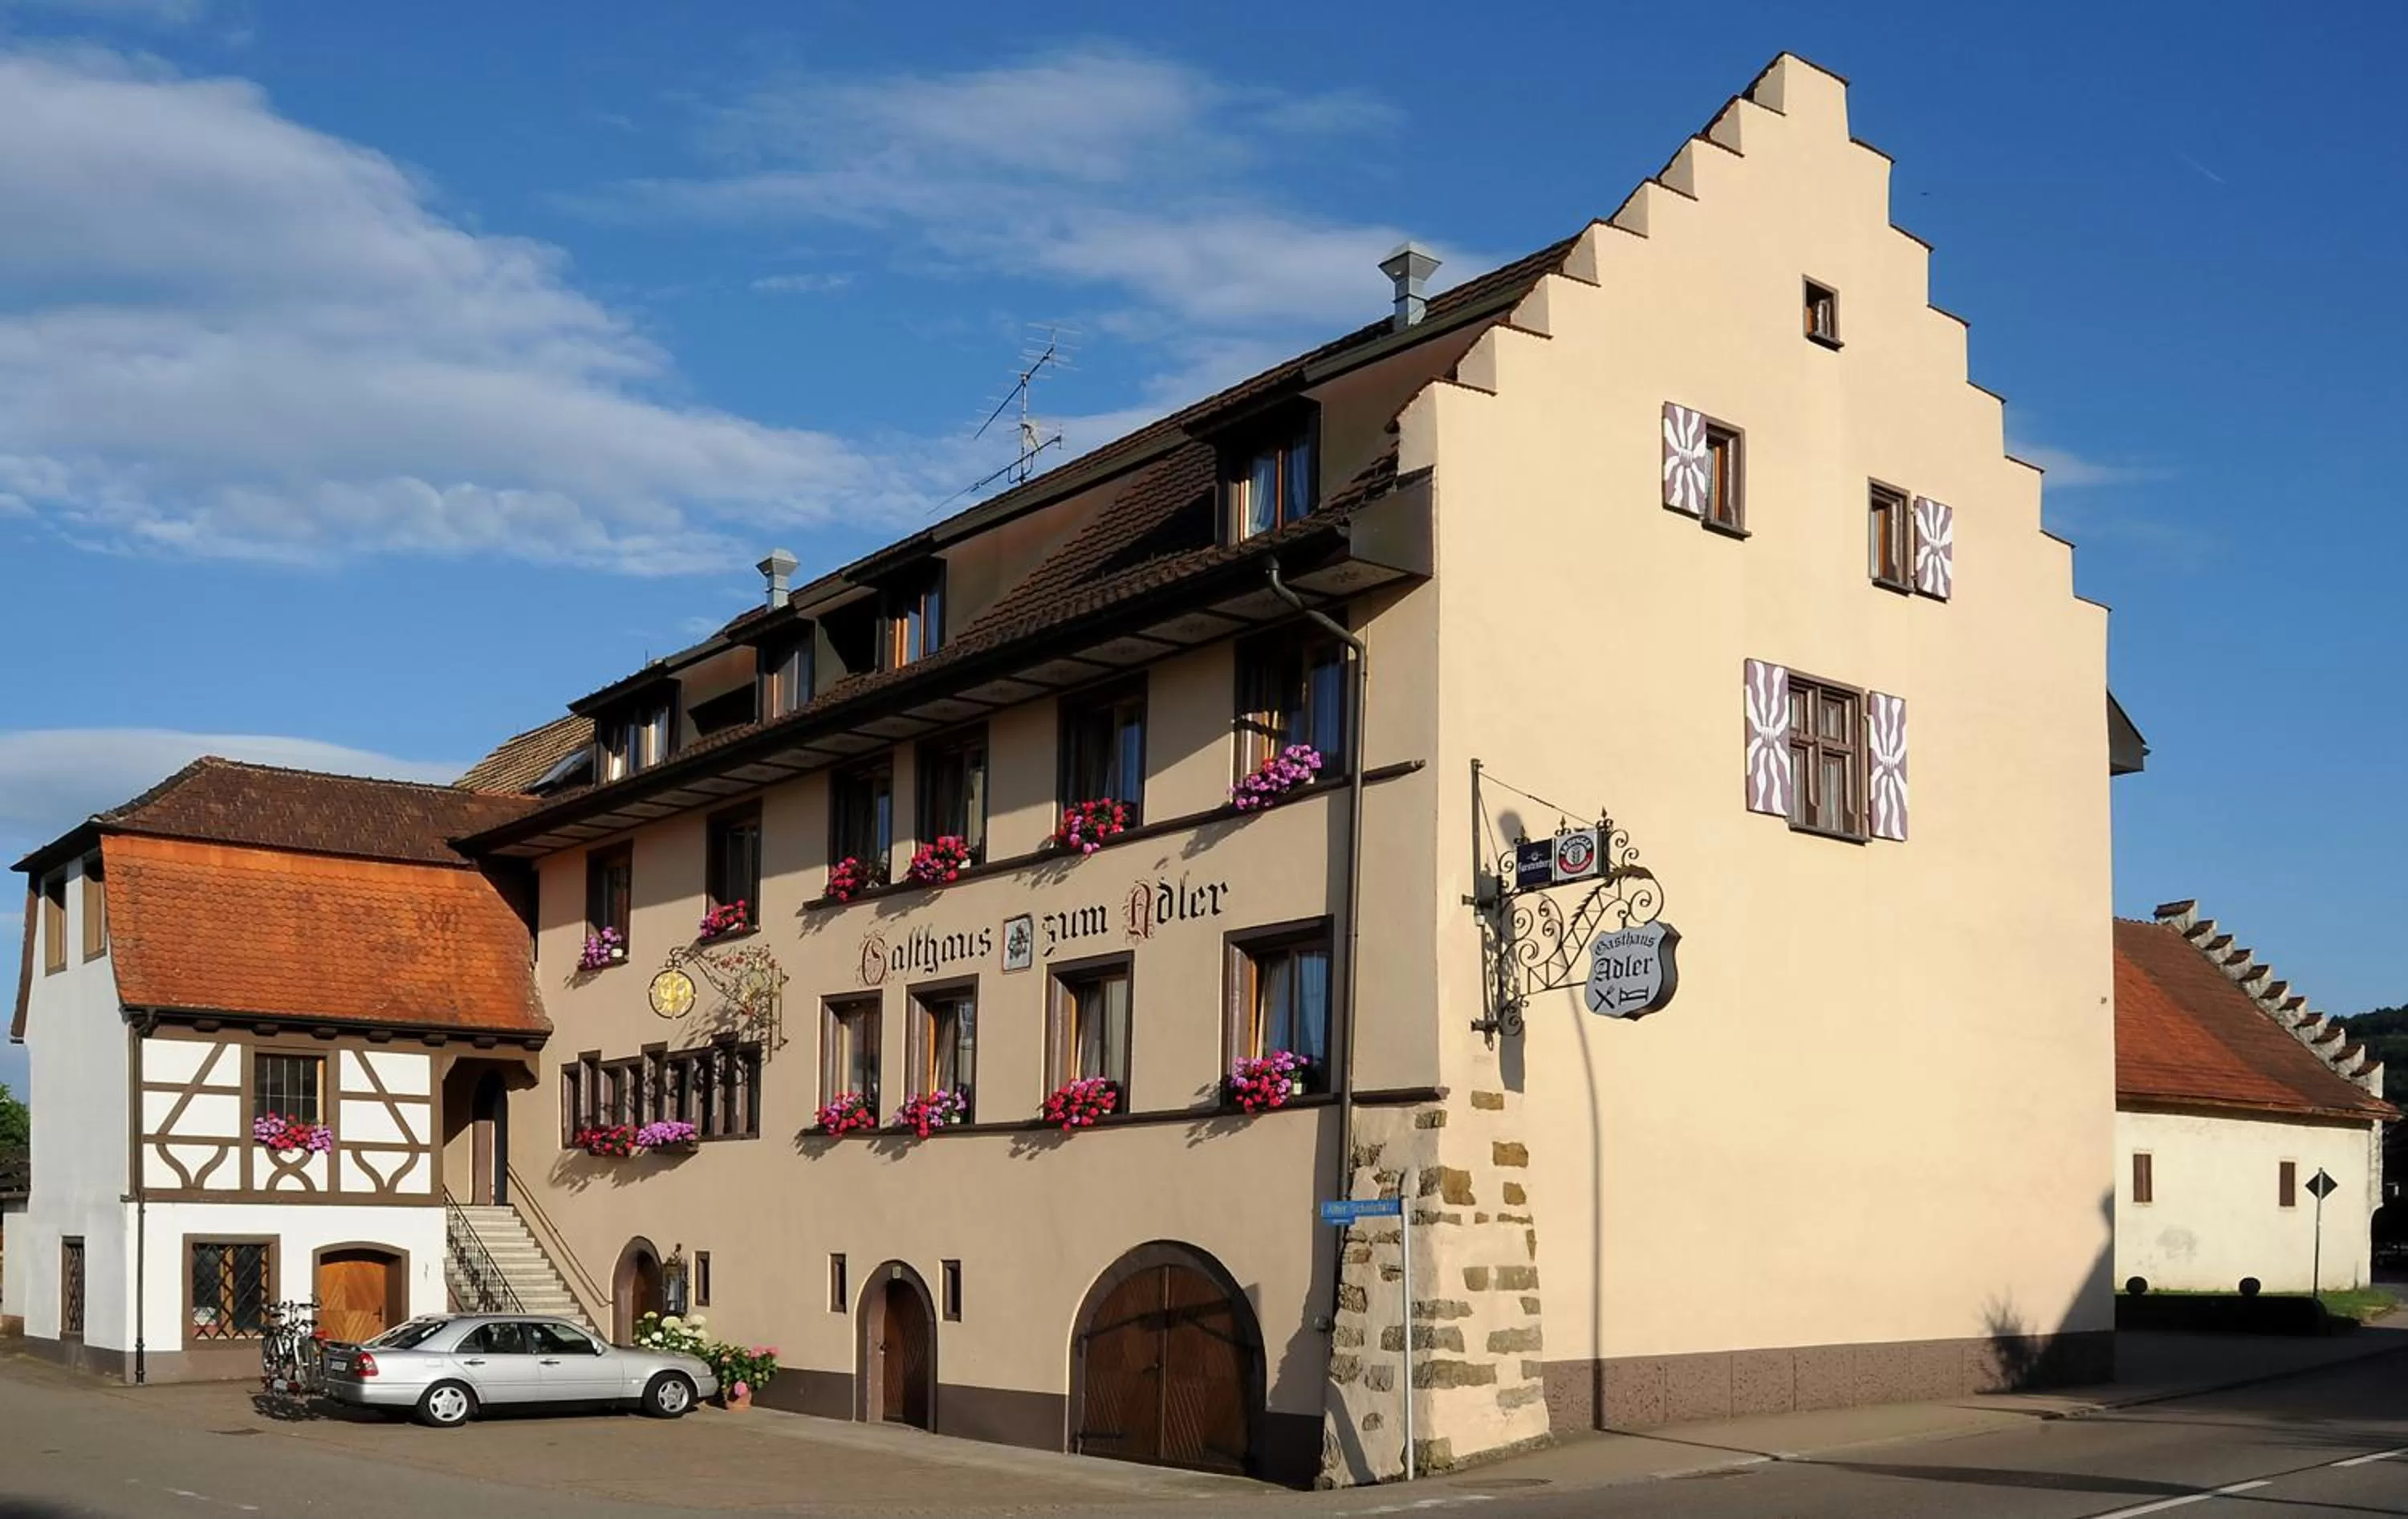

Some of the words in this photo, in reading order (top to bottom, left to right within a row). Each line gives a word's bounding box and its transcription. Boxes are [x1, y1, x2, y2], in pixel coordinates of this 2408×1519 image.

[1043, 905, 1108, 957] zum
[1126, 873, 1229, 939] Adler
[1595, 932, 1656, 955] Gasthaus
[1594, 955, 1653, 982] Adler
